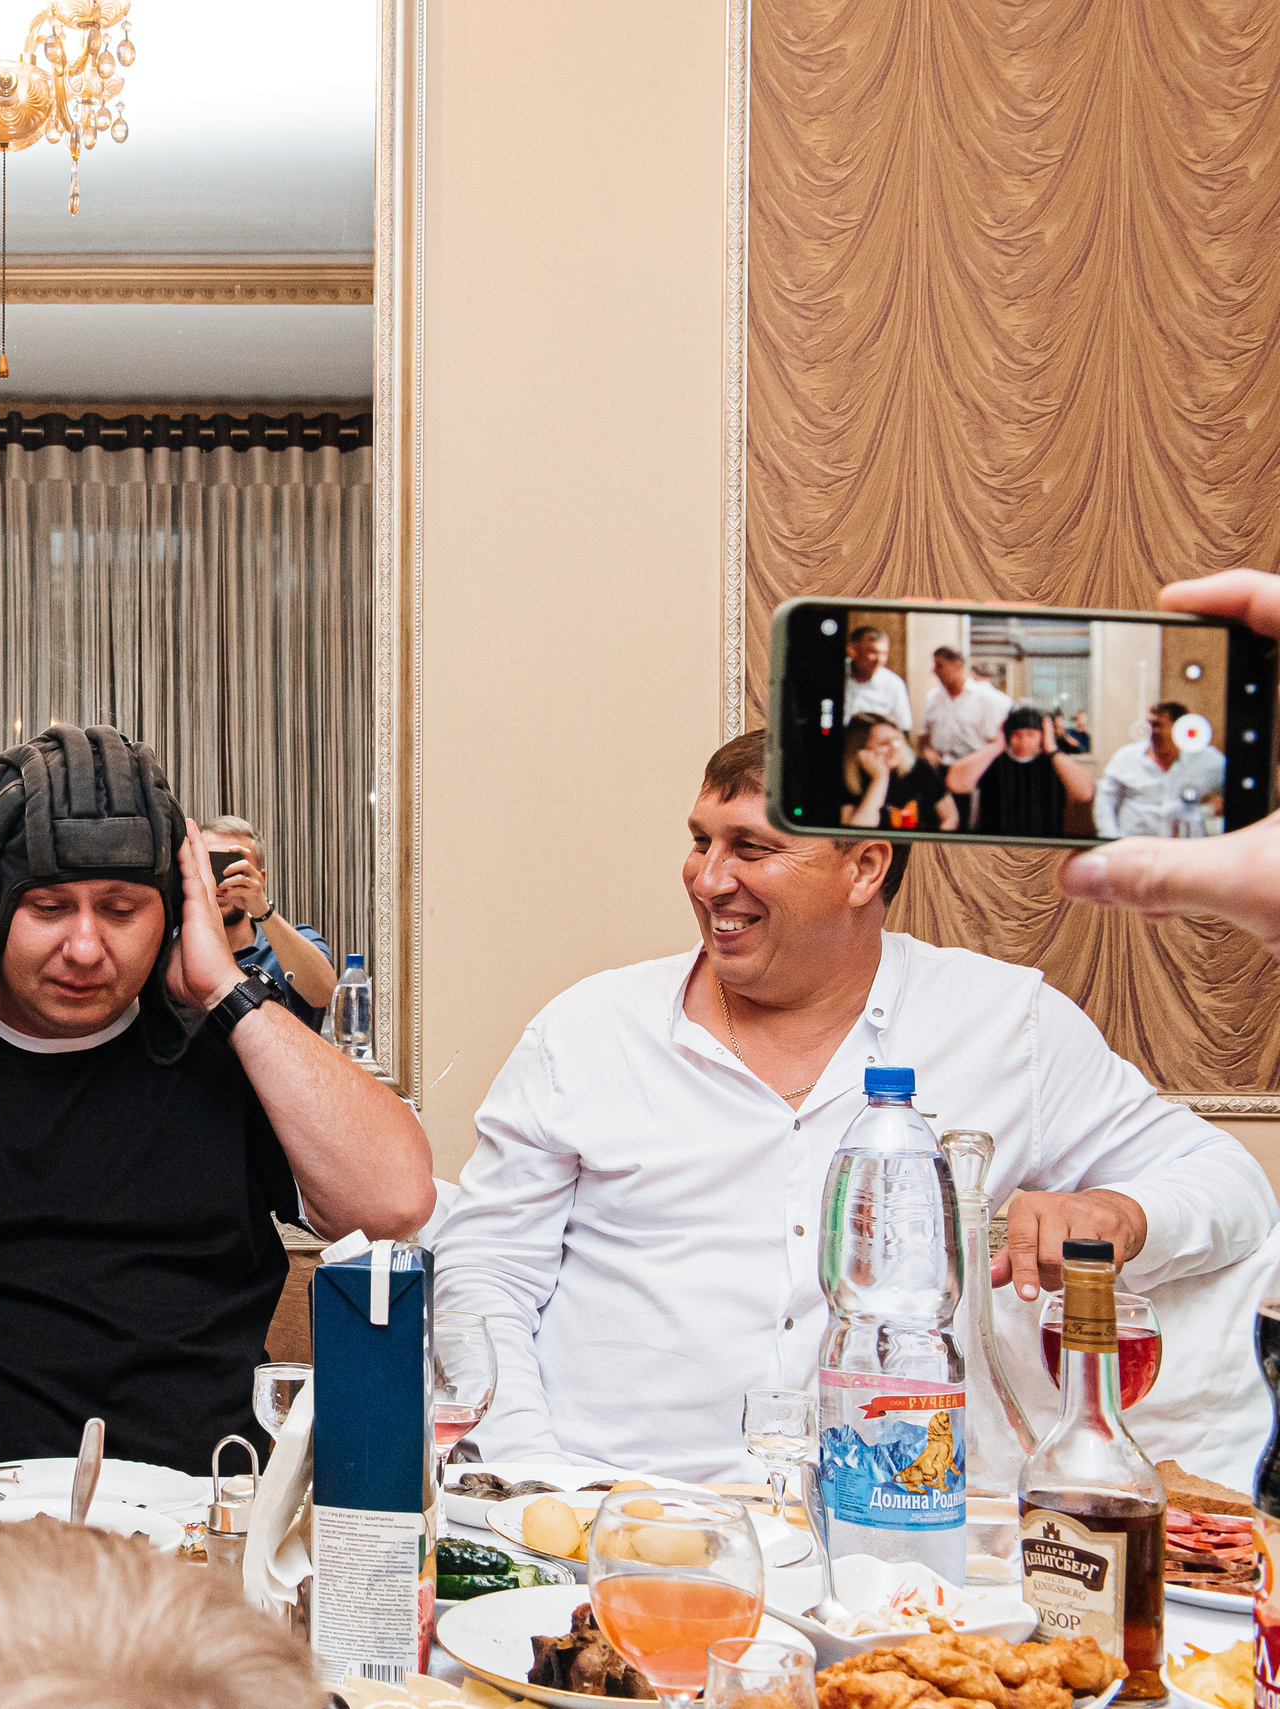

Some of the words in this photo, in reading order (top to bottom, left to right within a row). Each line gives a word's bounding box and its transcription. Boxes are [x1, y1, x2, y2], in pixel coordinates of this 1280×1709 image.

[870, 1487, 929, 1511] Долина
[932, 1489, 966, 1510] Родн
[1035, 1544, 1074, 1559] СТАРЫЙ
[1024, 1551, 1100, 1580] КЕНИГСБЕРГ
[1033, 1580, 1087, 1601] KENIGSBERG
[1044, 1576, 1064, 1584] OLD
[1038, 1607, 1080, 1630] VSOP
